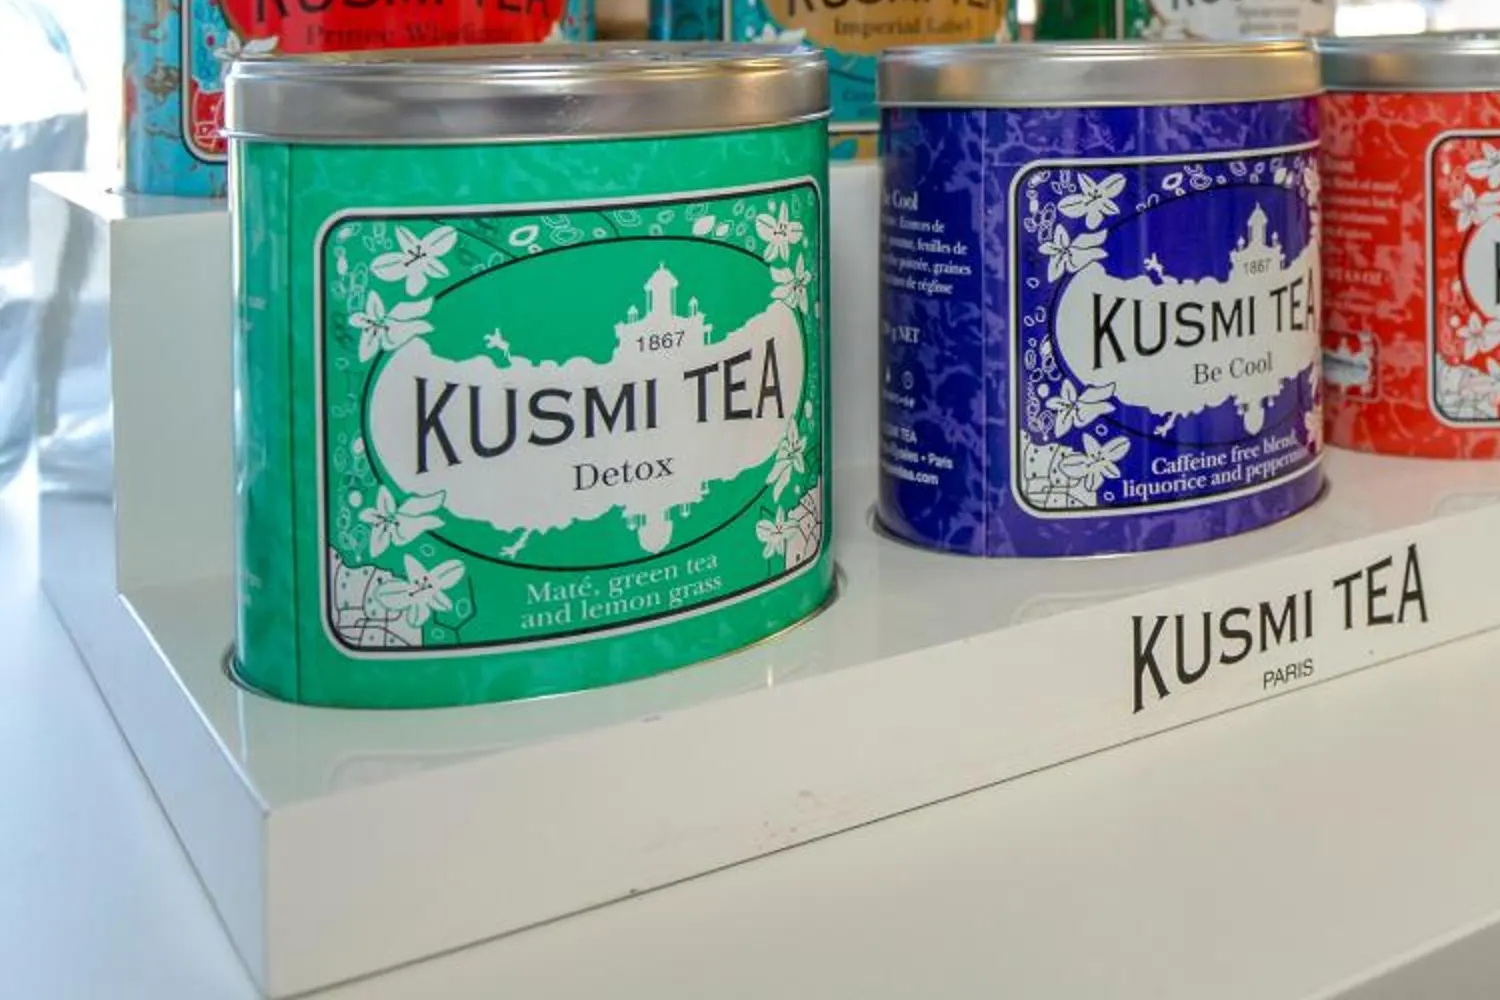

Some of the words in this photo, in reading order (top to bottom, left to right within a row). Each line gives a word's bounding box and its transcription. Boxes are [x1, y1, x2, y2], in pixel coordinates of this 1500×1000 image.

[932, 260, 972, 276] graines
[1243, 258, 1273, 276] 1867
[1092, 292, 1255, 370] KUSMI
[1270, 268, 1315, 333] TEA
[637, 330, 686, 351] 1867
[1193, 363, 1222, 385] Be
[1229, 351, 1274, 379] Cool
[415, 376, 658, 474] KUSMI
[683, 337, 784, 423] TEA
[573, 456, 675, 492] Detox
[1151, 450, 1228, 476] Caffeine
[1231, 445, 1259, 463] free
[1122, 474, 1208, 500] liquorice
[1210, 464, 1242, 486] and
[609, 565, 678, 597] green
[686, 553, 718, 575] tea
[520, 602, 571, 629] and
[582, 591, 660, 620] lemon
[669, 575, 722, 608] grass
[1131, 589, 1313, 714] KUSMI
[1333, 542, 1429, 630] TEA
[1262, 658, 1314, 690] PARIS
